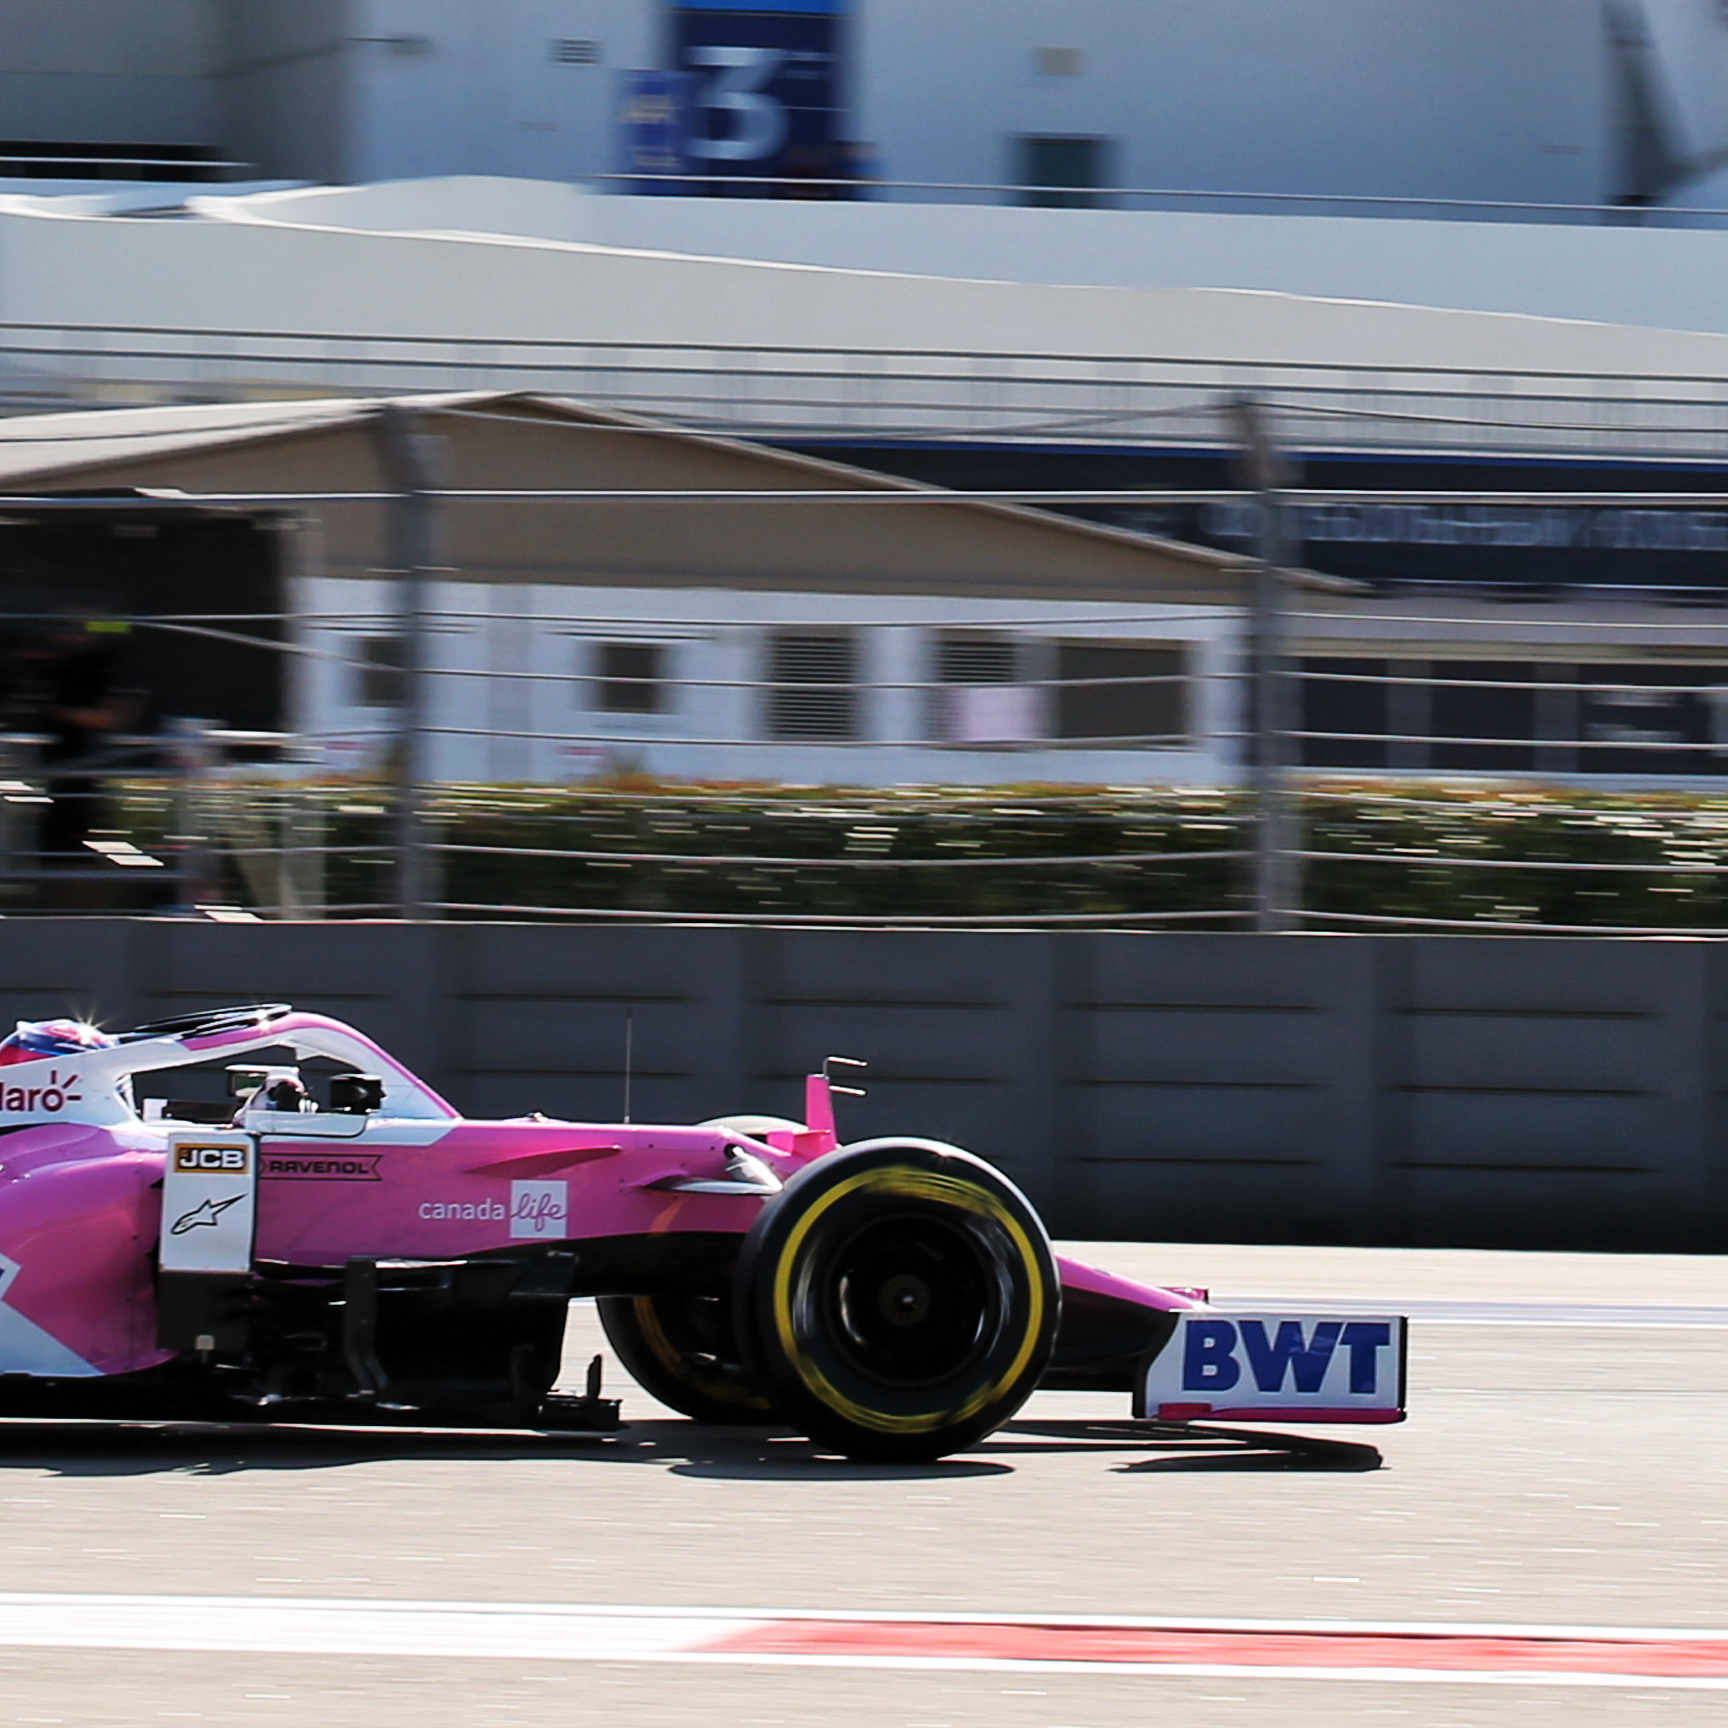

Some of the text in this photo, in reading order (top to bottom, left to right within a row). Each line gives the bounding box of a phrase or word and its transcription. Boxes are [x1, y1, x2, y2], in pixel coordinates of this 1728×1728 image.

[686, 46, 789, 160] 3
[179, 1149, 245, 1169] JCB
[270, 1160, 371, 1175] RAVENOL
[418, 1192, 567, 1232] canada life
[1181, 1319, 1391, 1395] BWT
